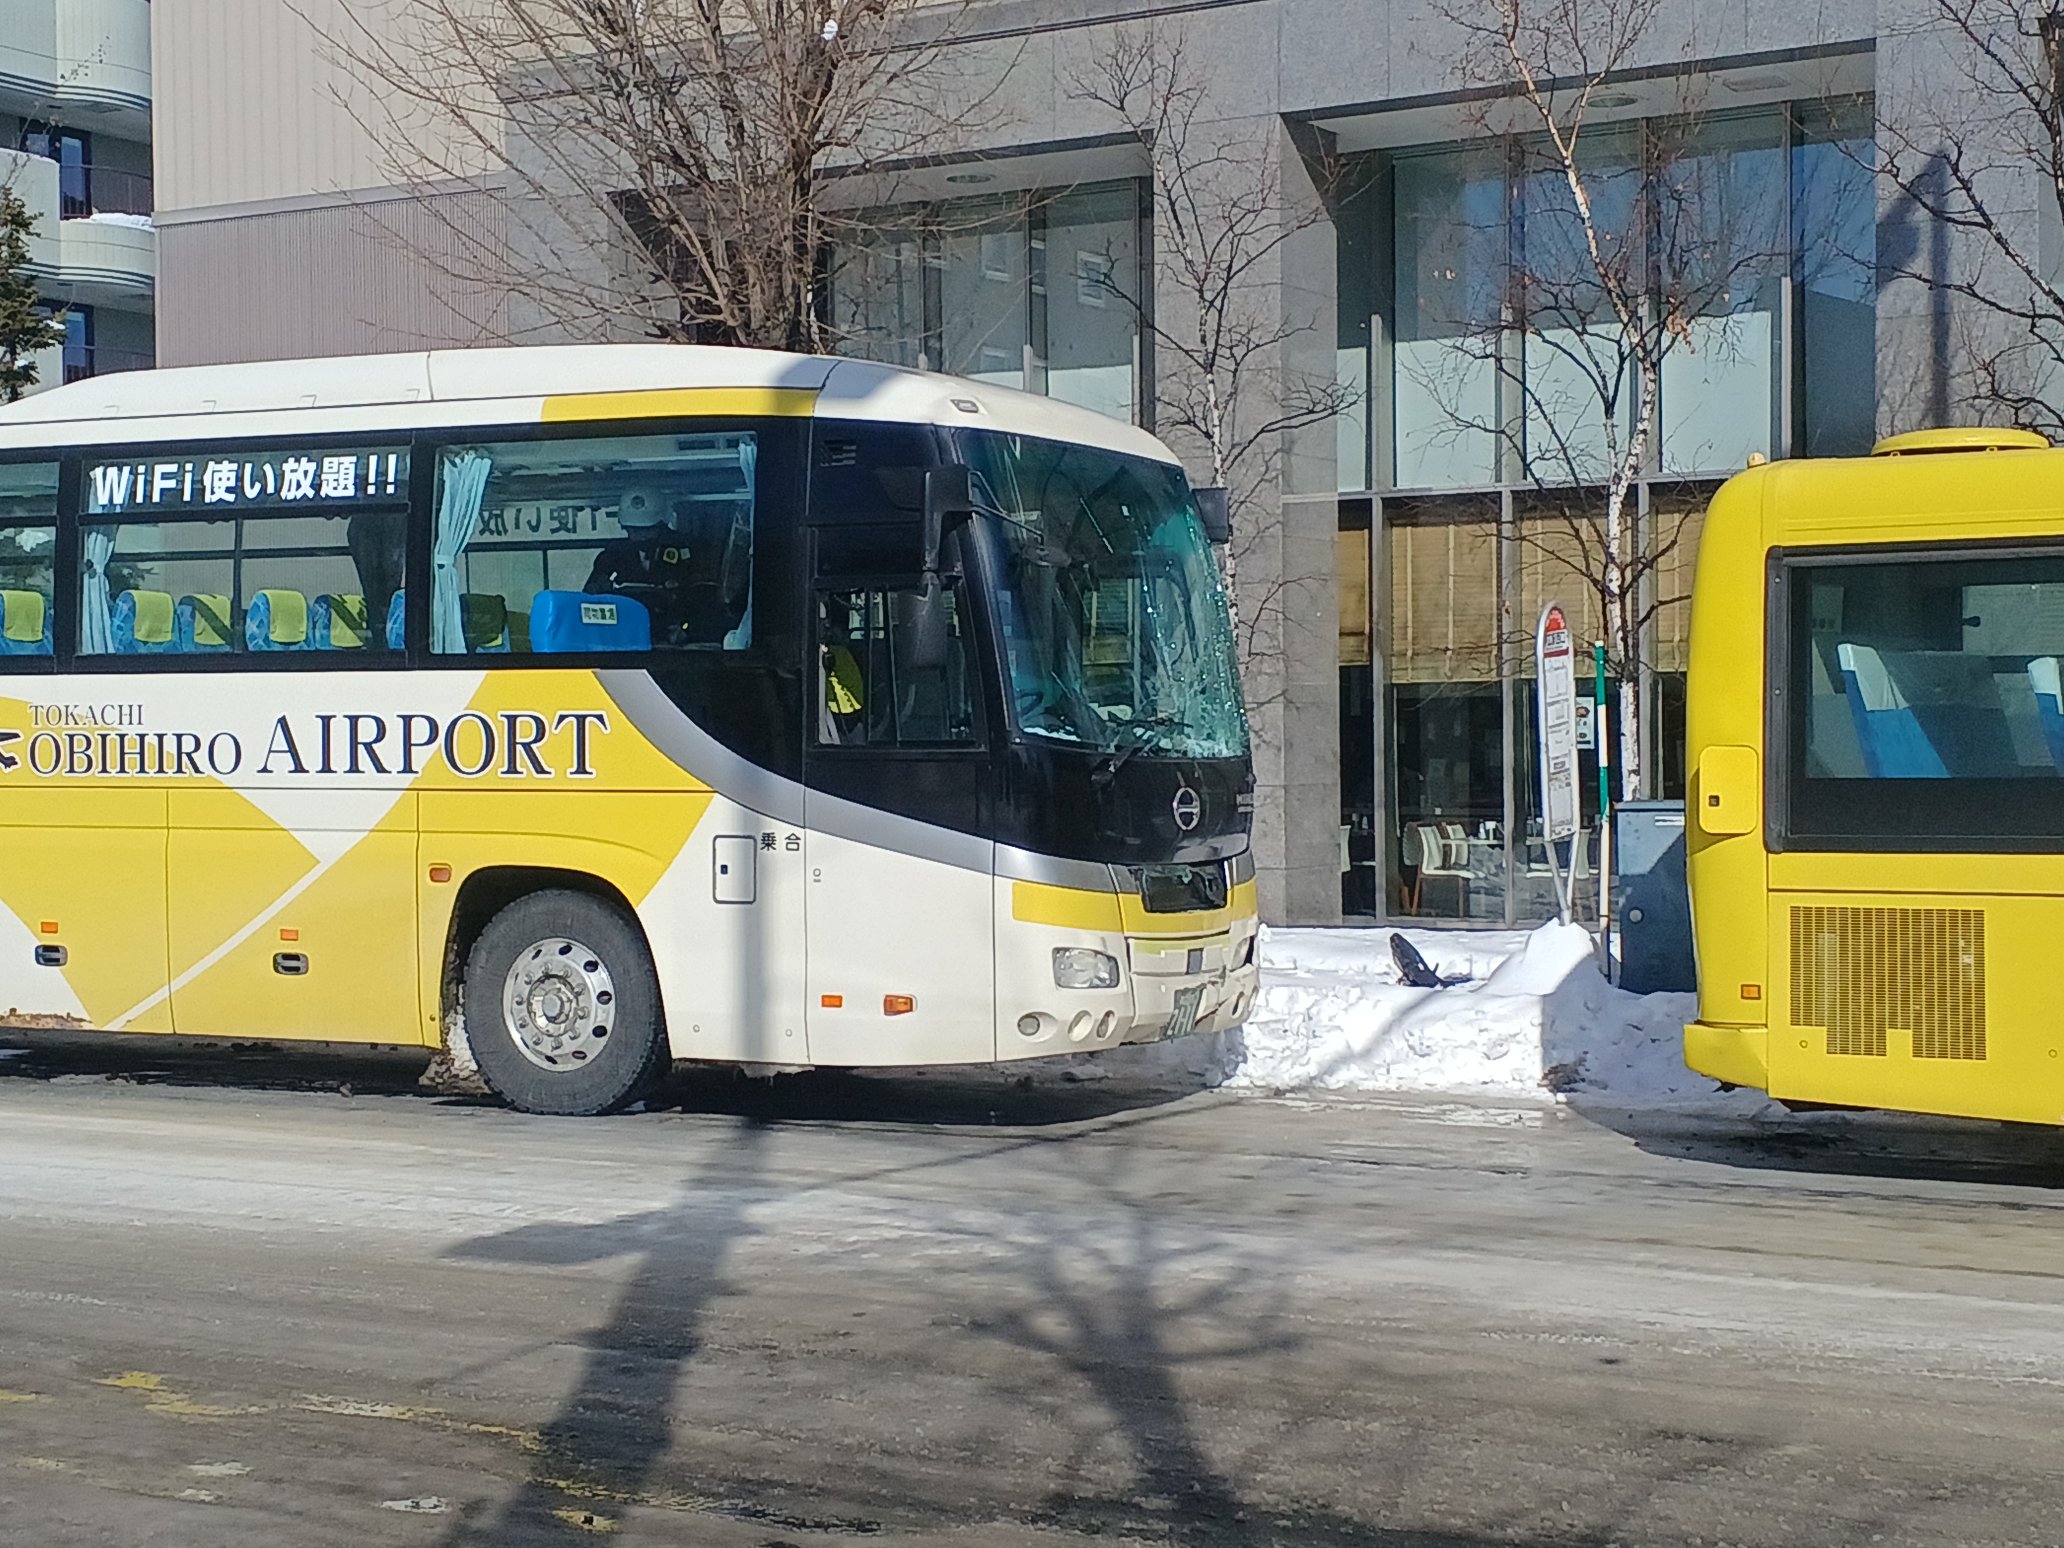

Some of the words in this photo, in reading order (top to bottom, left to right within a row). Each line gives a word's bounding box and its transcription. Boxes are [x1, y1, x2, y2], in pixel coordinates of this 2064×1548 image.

[29, 704, 144, 726] TOKACHI
[29, 732, 242, 775] OBIHIRO
[256, 713, 608, 775] AIRPORT
[760, 832, 801, 851] 乗合
